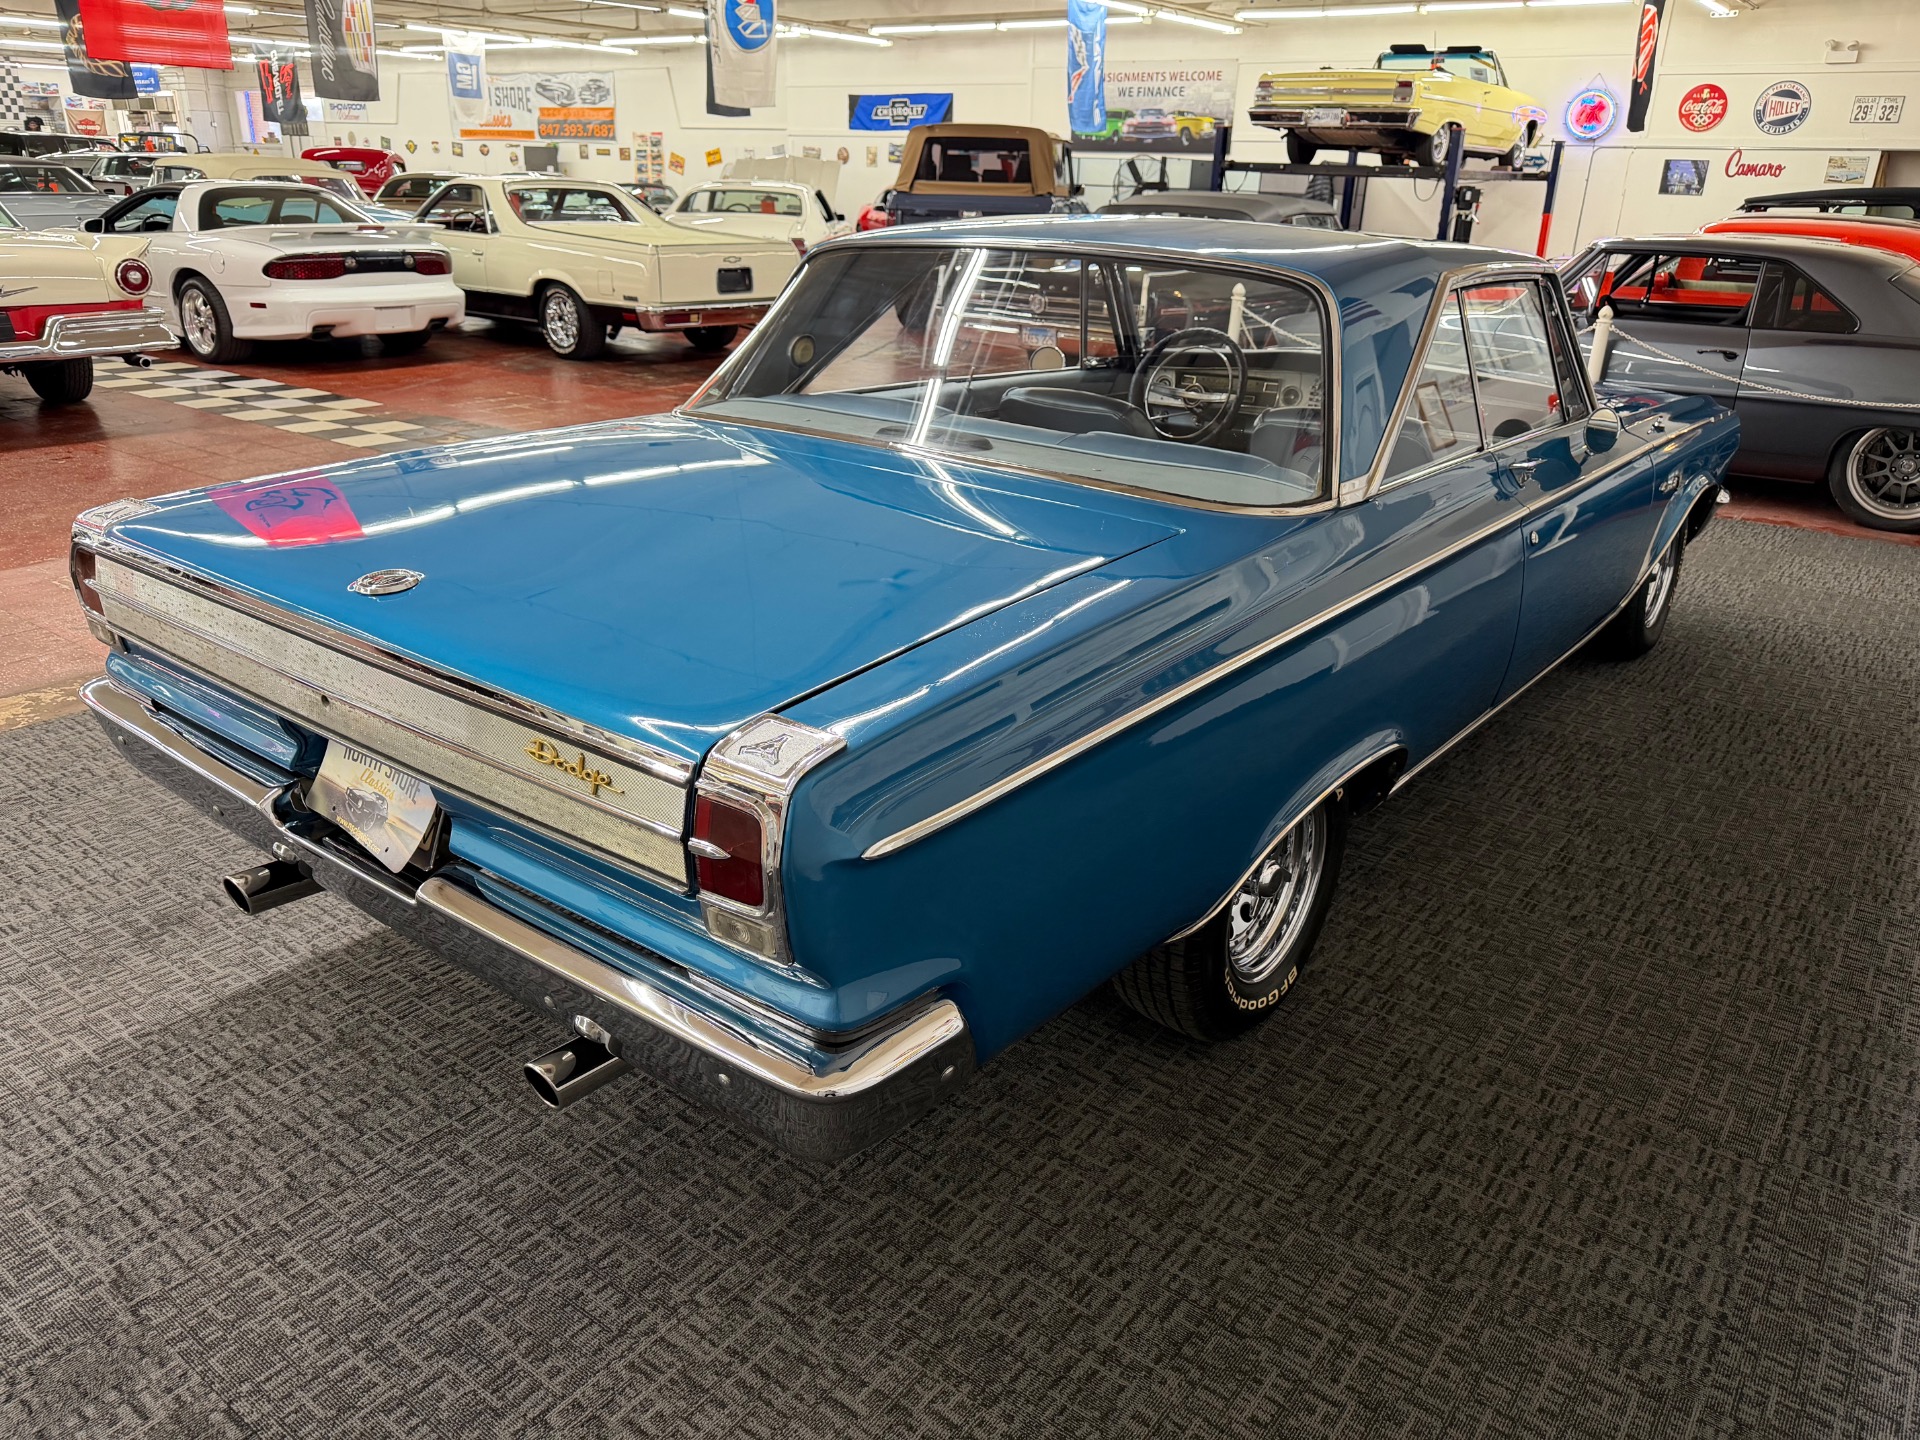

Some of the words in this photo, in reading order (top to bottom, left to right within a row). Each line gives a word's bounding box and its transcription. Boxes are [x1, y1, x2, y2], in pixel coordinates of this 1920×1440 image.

[1104, 71, 1166, 83] SIGNMENTS
[1169, 70, 1223, 82] WELCOME
[494, 86, 532, 113] SHORE
[1117, 86, 1134, 97] WE
[1136, 86, 1186, 97] FINANCE
[1771, 84, 1809, 105] PERFORMANCE
[876, 106, 923, 116] CHEVROLET
[1768, 99, 1801, 118] HOLLEY
[539, 123, 615, 137] 847.393.7887
[1724, 149, 1786, 178] Camaro
[524, 737, 625, 795] Dodge
[359, 767, 396, 801] Classics
[1224, 965, 1298, 1011] BFGoodrich
